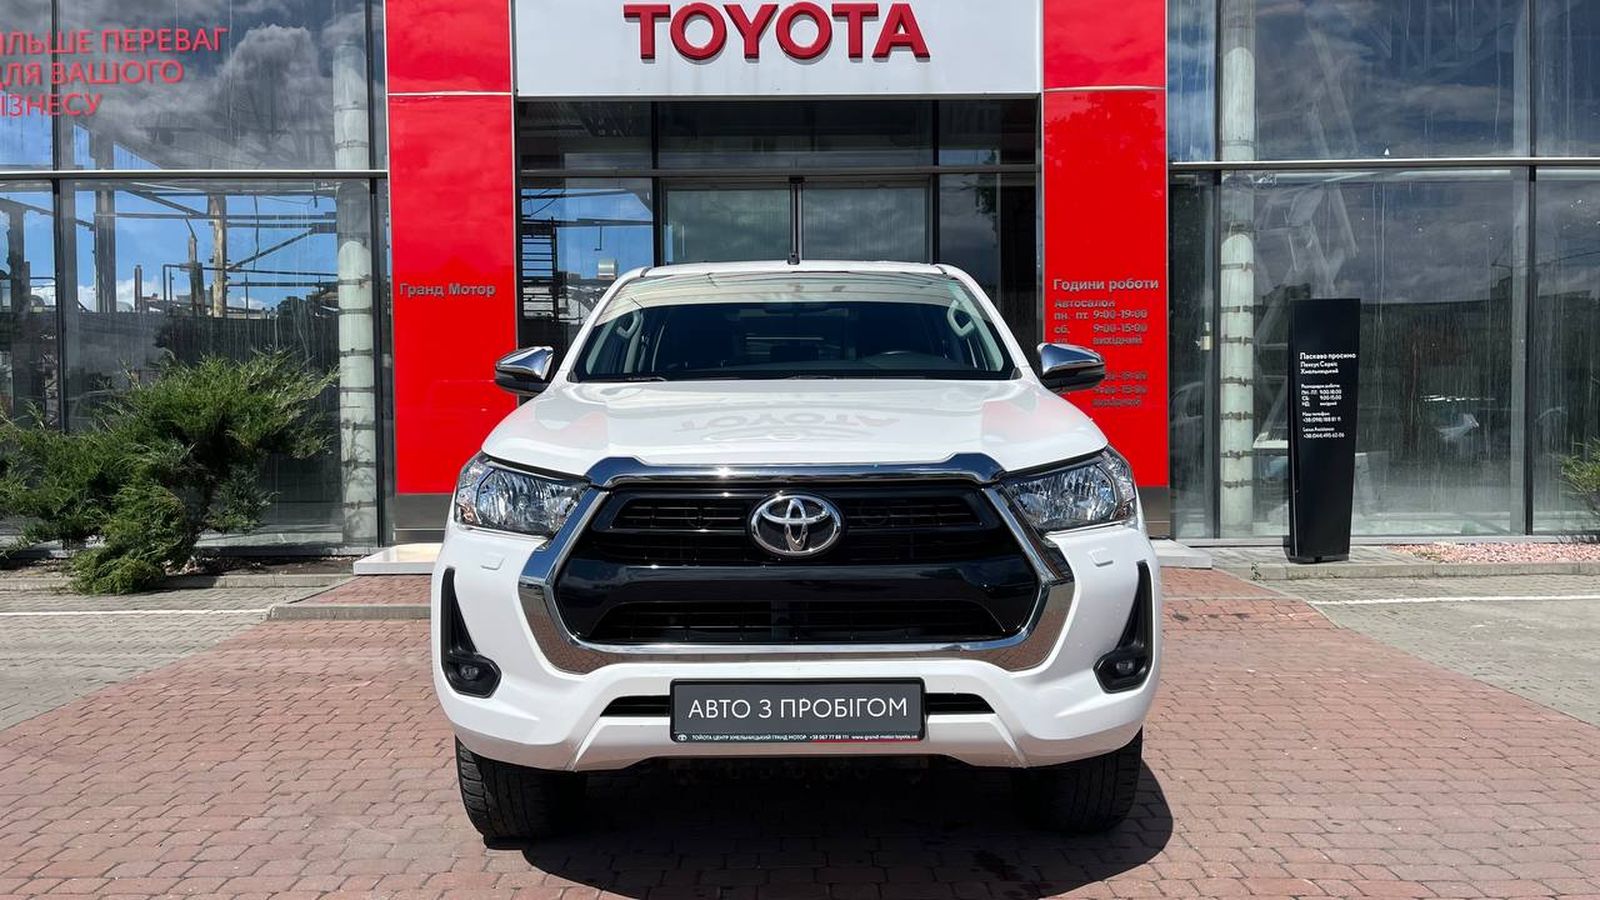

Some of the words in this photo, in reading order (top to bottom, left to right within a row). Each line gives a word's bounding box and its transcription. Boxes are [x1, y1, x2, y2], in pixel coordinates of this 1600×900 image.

[102, 28, 227, 53] ПЕРЕВАГ
[623, 2, 930, 61] TOYOTA
[51, 59, 184, 85] ВАШОГО
[399, 283, 444, 297] Гранд
[448, 283, 496, 297] Мотор
[1053, 279, 1104, 291] Години
[1109, 277, 1159, 291] роботи
[688, 699, 751, 719] АВТО
[758, 699, 772, 719] З
[780, 697, 908, 719] ПРОБІГОМ
